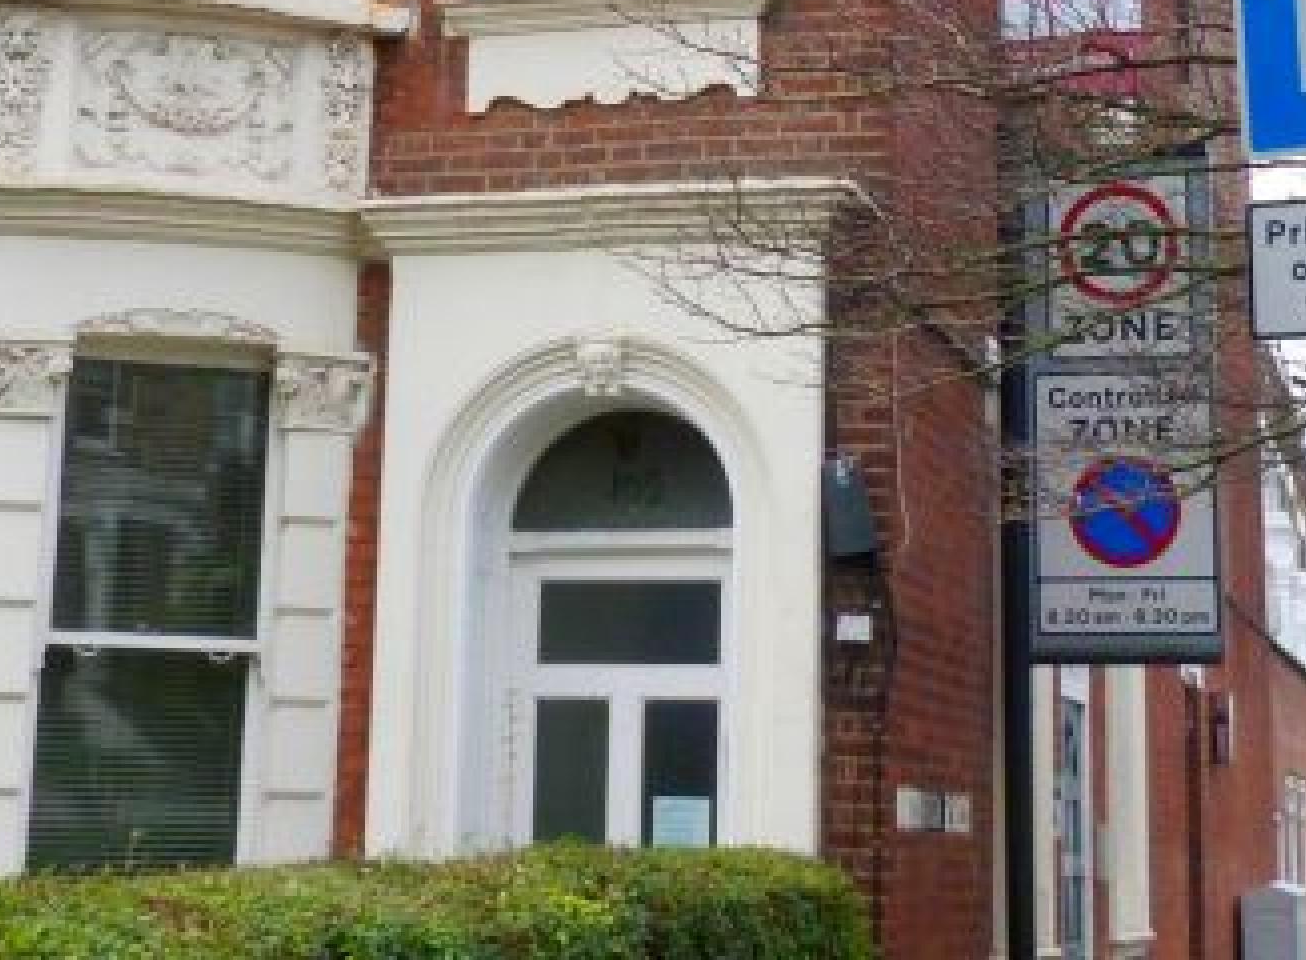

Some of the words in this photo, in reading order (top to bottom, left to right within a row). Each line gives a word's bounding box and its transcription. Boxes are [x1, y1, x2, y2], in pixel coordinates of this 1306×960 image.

[1079, 219, 1159, 268] 20
[1065, 311, 1175, 343] ZONE
[1067, 414, 1175, 444] ZONE
